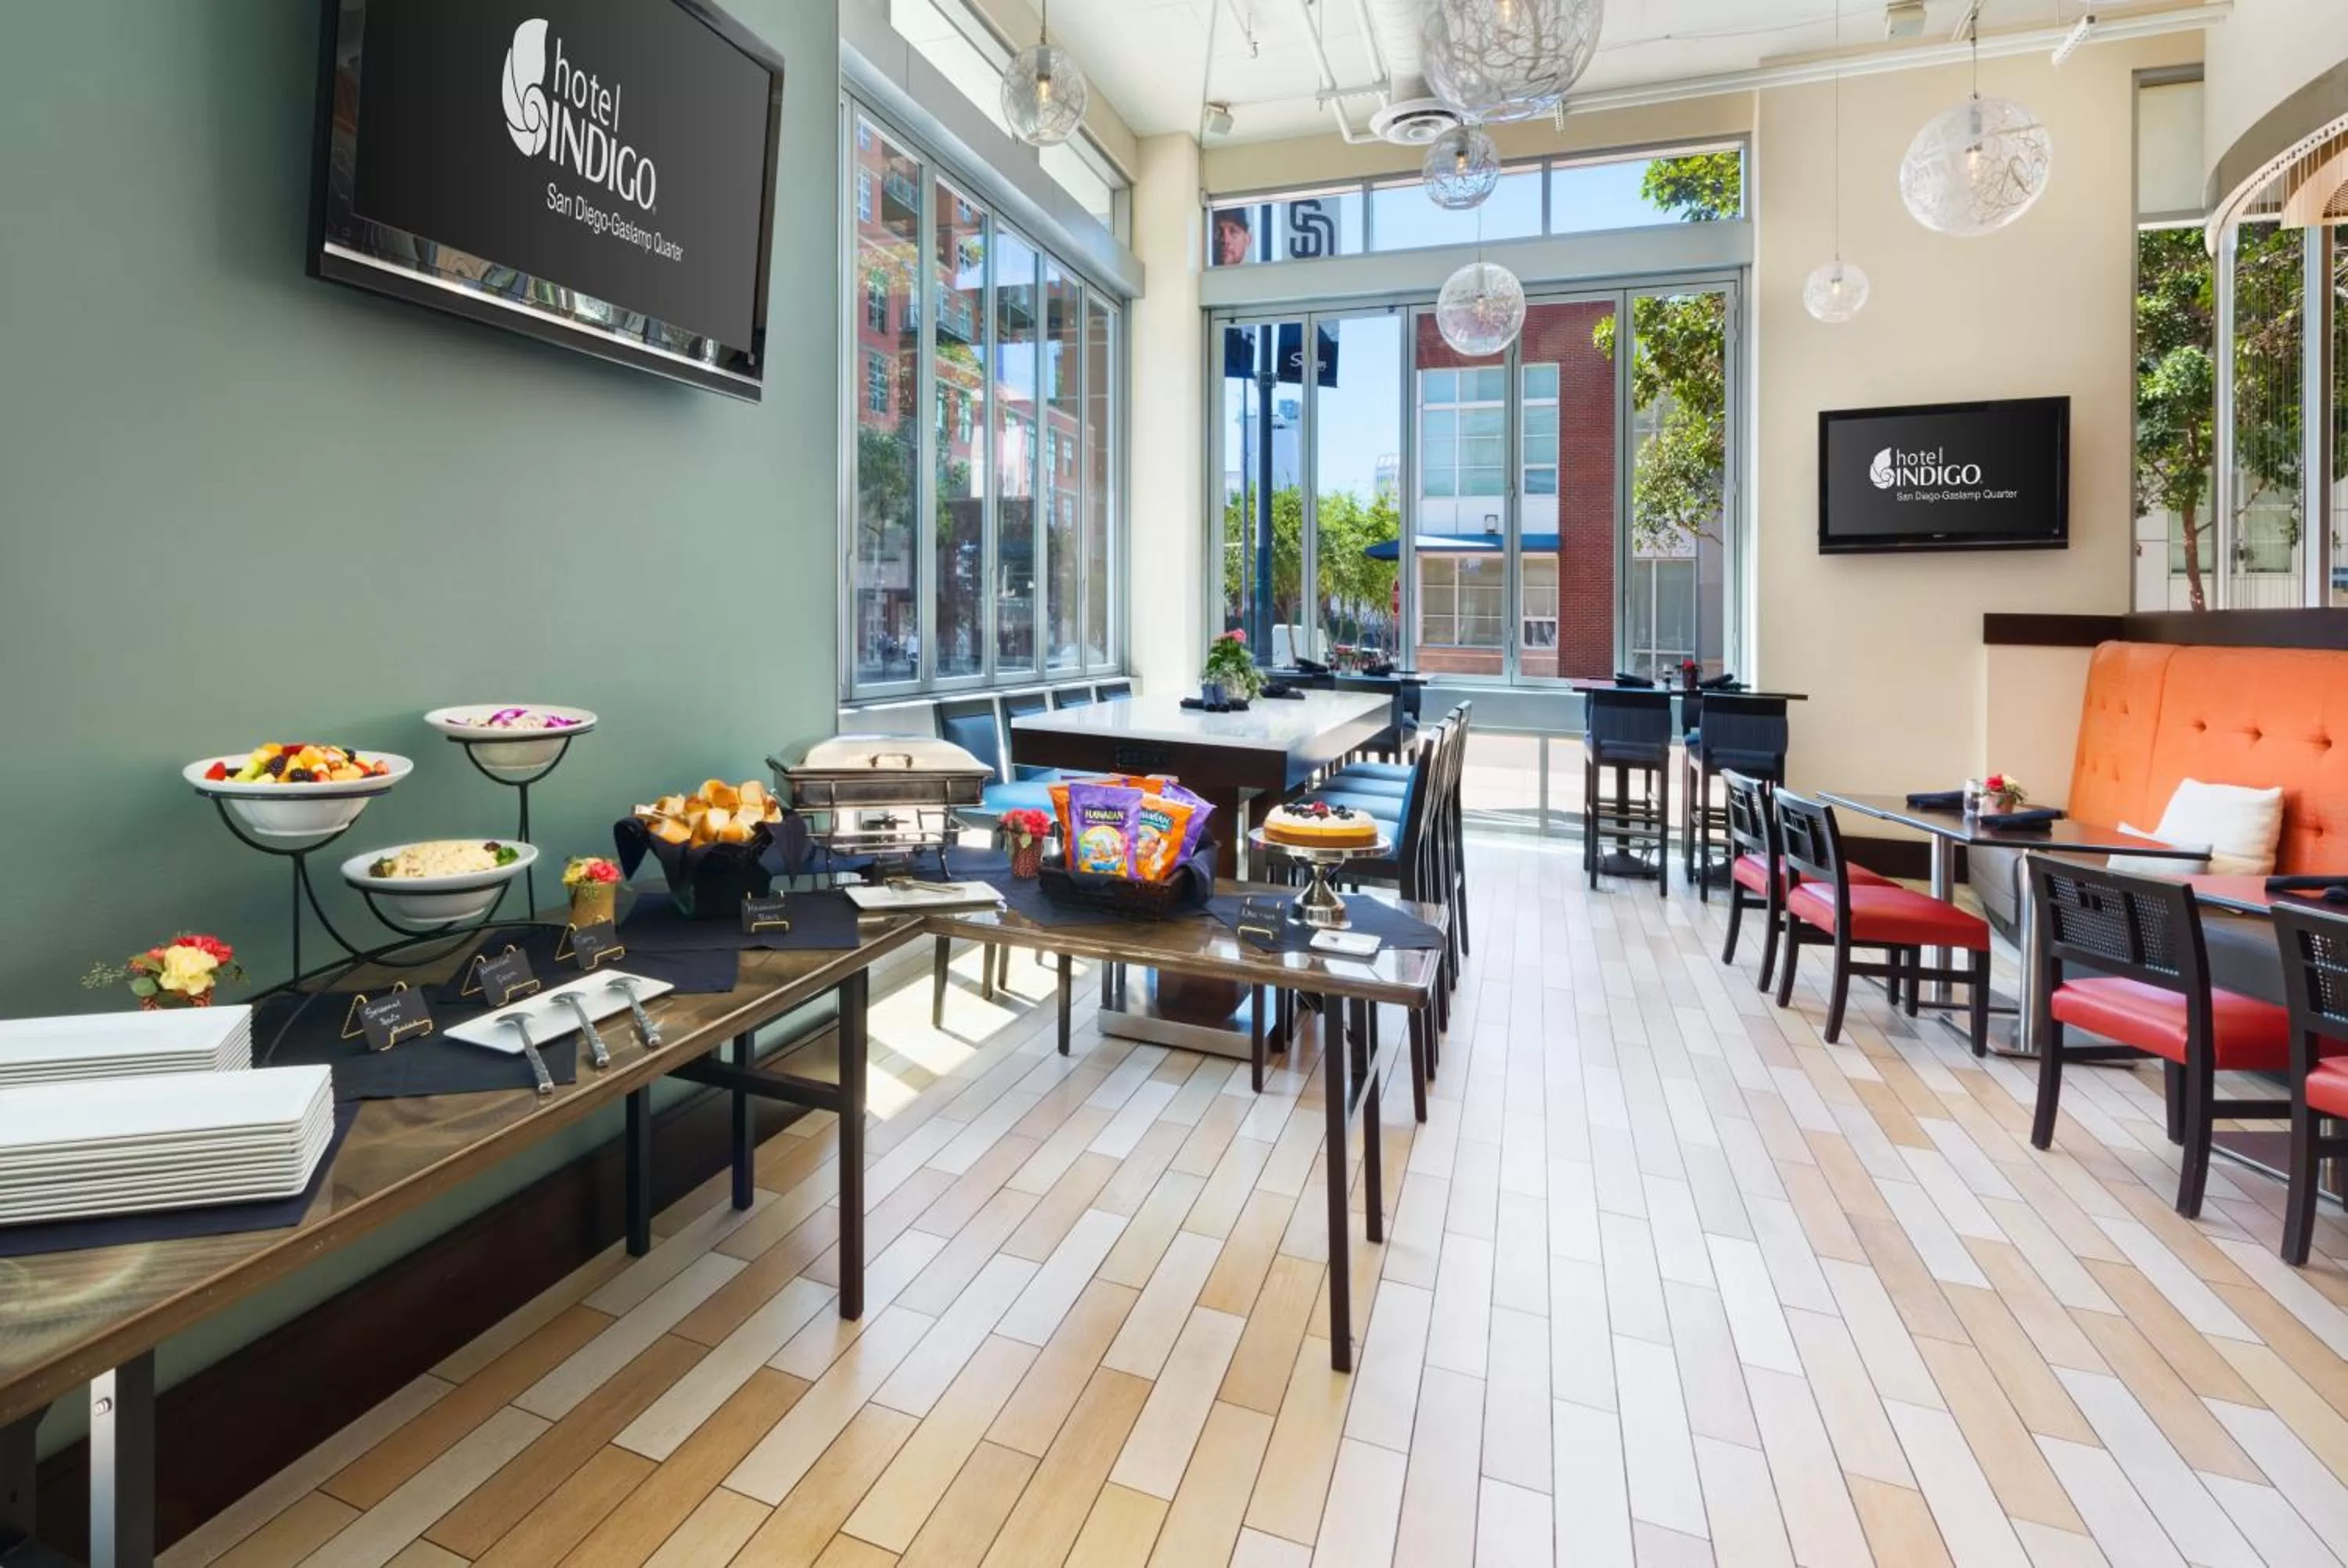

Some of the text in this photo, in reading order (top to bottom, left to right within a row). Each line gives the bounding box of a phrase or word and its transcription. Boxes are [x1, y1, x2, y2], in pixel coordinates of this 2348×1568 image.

[554, 38, 621, 132] hotel
[549, 100, 657, 210] INDIGO
[547, 182, 573, 217] San
[654, 232, 684, 263] Quarter
[1896, 446, 1943, 466] hotel
[1896, 464, 1982, 487] INDIGO
[1896, 491, 1914, 502] San
[1982, 488, 2018, 499] Quarter
